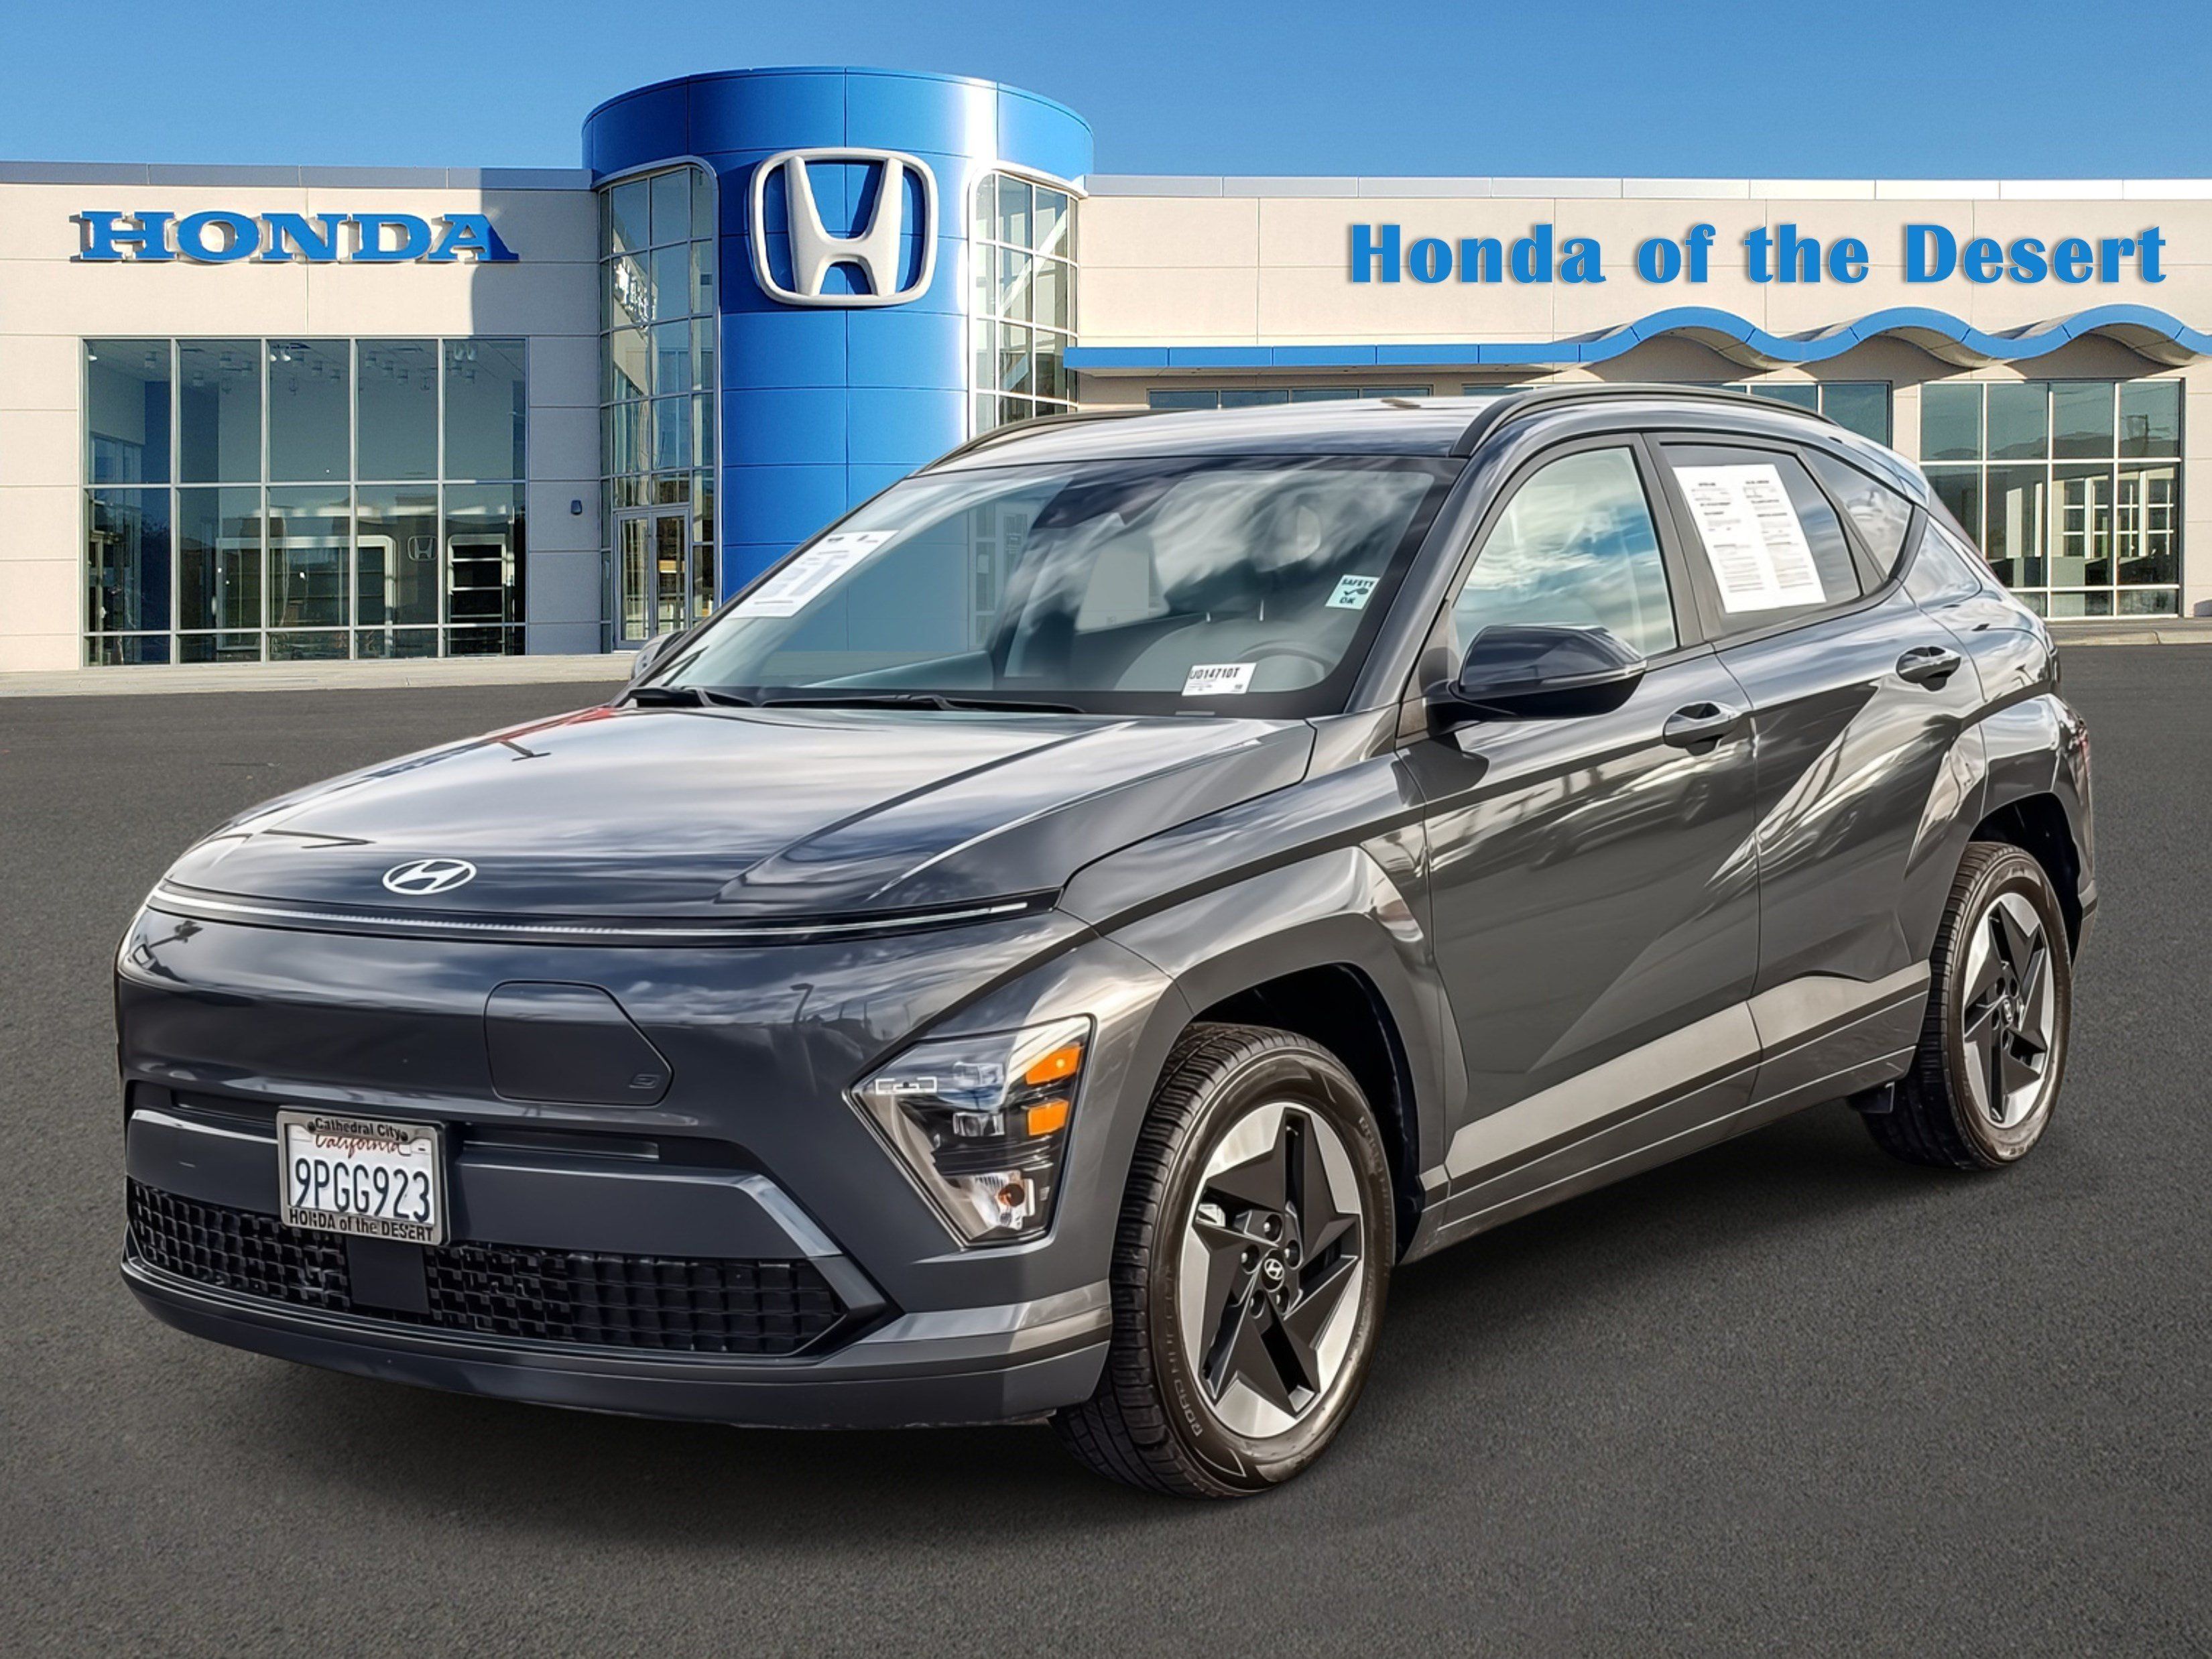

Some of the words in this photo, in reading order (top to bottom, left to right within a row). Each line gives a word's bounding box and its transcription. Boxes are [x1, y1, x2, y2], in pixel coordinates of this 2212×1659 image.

[80, 210, 519, 261] HONDA
[1351, 223, 1607, 284] Honda
[1638, 223, 1717, 284] of
[1743, 223, 1869, 284] the
[1906, 224, 2168, 284] Desert
[1341, 578, 1375, 588] SAFETY
[1339, 596, 1355, 604] OK
[314, 1117, 373, 1134] Cathedral
[377, 1124, 402, 1142] City
[295, 1157, 431, 1223] 9PGG923
[289, 1209, 336, 1229] HONDA
[339, 1215, 352, 1231] of
[356, 1217, 378, 1235] the
[381, 1220, 434, 1241] DESERT
